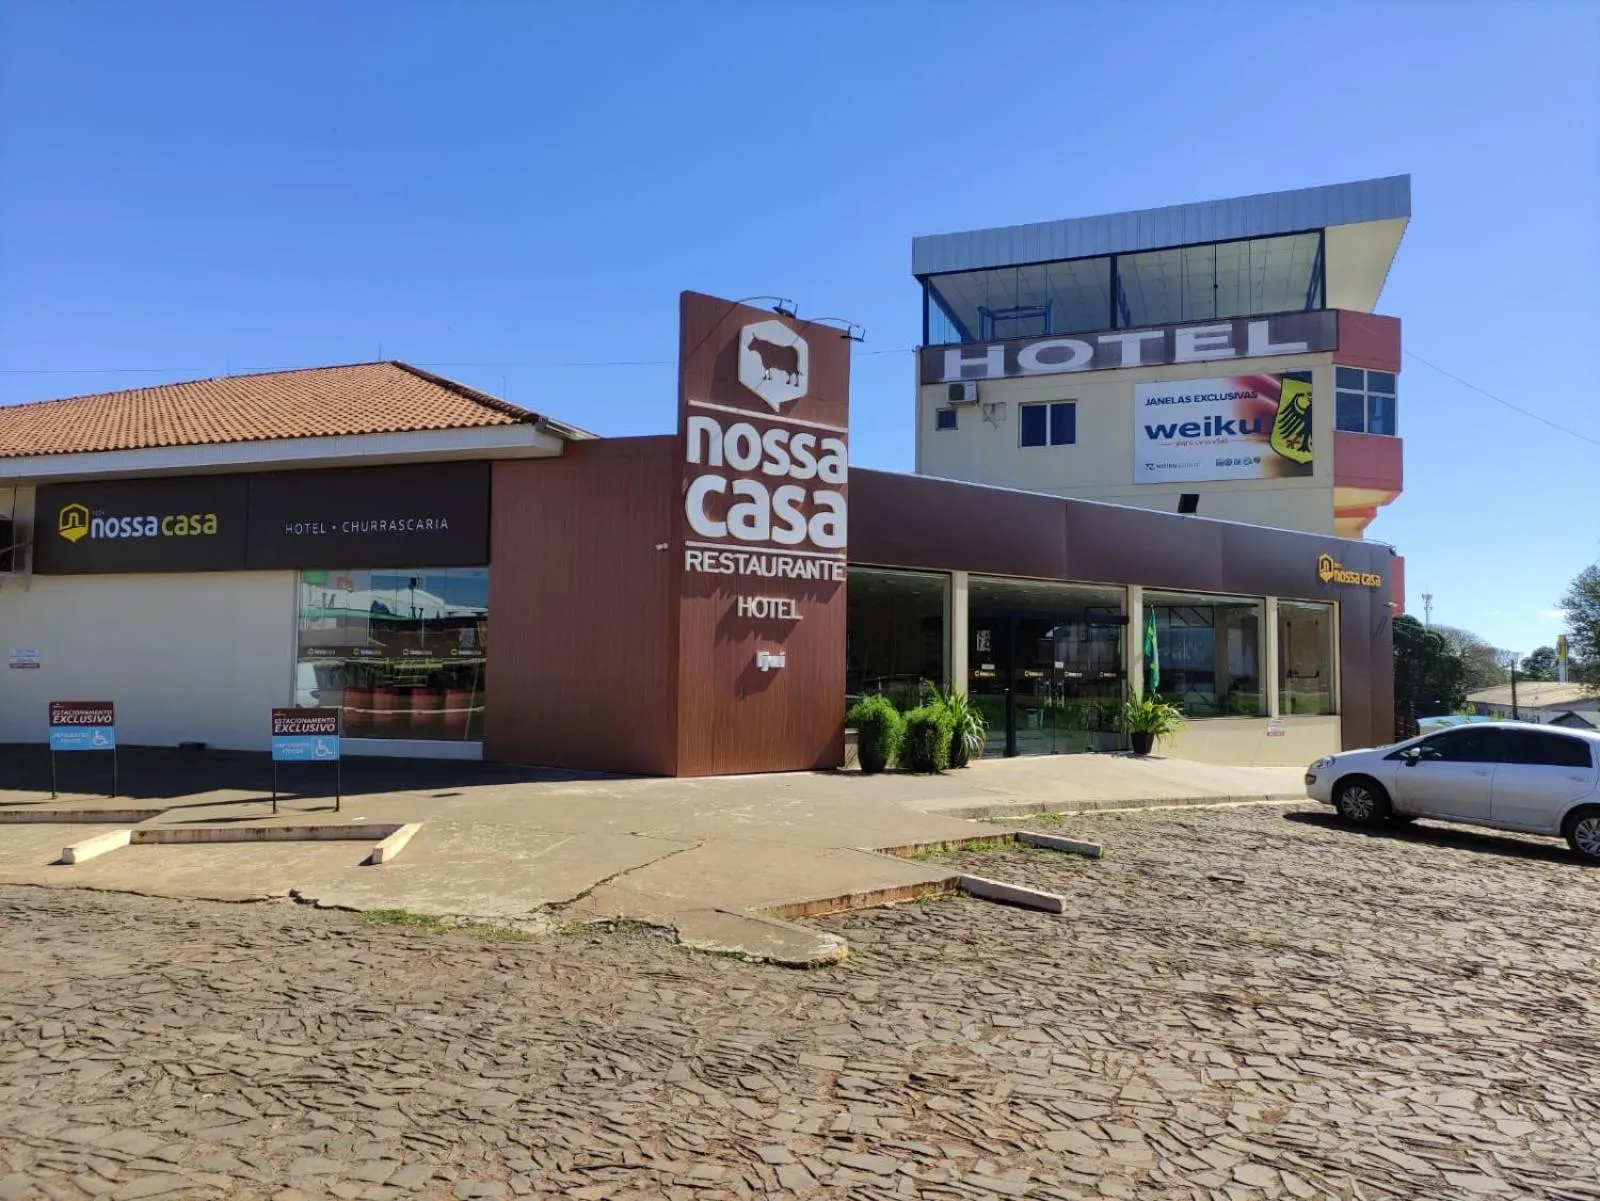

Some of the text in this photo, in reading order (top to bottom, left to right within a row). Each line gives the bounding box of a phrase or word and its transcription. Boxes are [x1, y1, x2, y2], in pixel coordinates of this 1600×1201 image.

[943, 320, 1307, 378] HOTEL
[1145, 391, 1258, 406] JANELAS EXCLUSIVAS
[1144, 415, 1262, 440] weiku
[687, 416, 848, 484] nossa
[685, 474, 847, 549] casa
[91, 513, 218, 539] nossa casa
[285, 518, 449, 535] HOTEL CHURRASCARIA
[685, 550, 847, 582] RESTAURANTE
[1334, 570, 1382, 588] nossa casa
[737, 595, 804, 620] HOTEL
[53, 715, 112, 724] EXCLUSIVO
[274, 723, 336, 733] EXCLUSIVO
